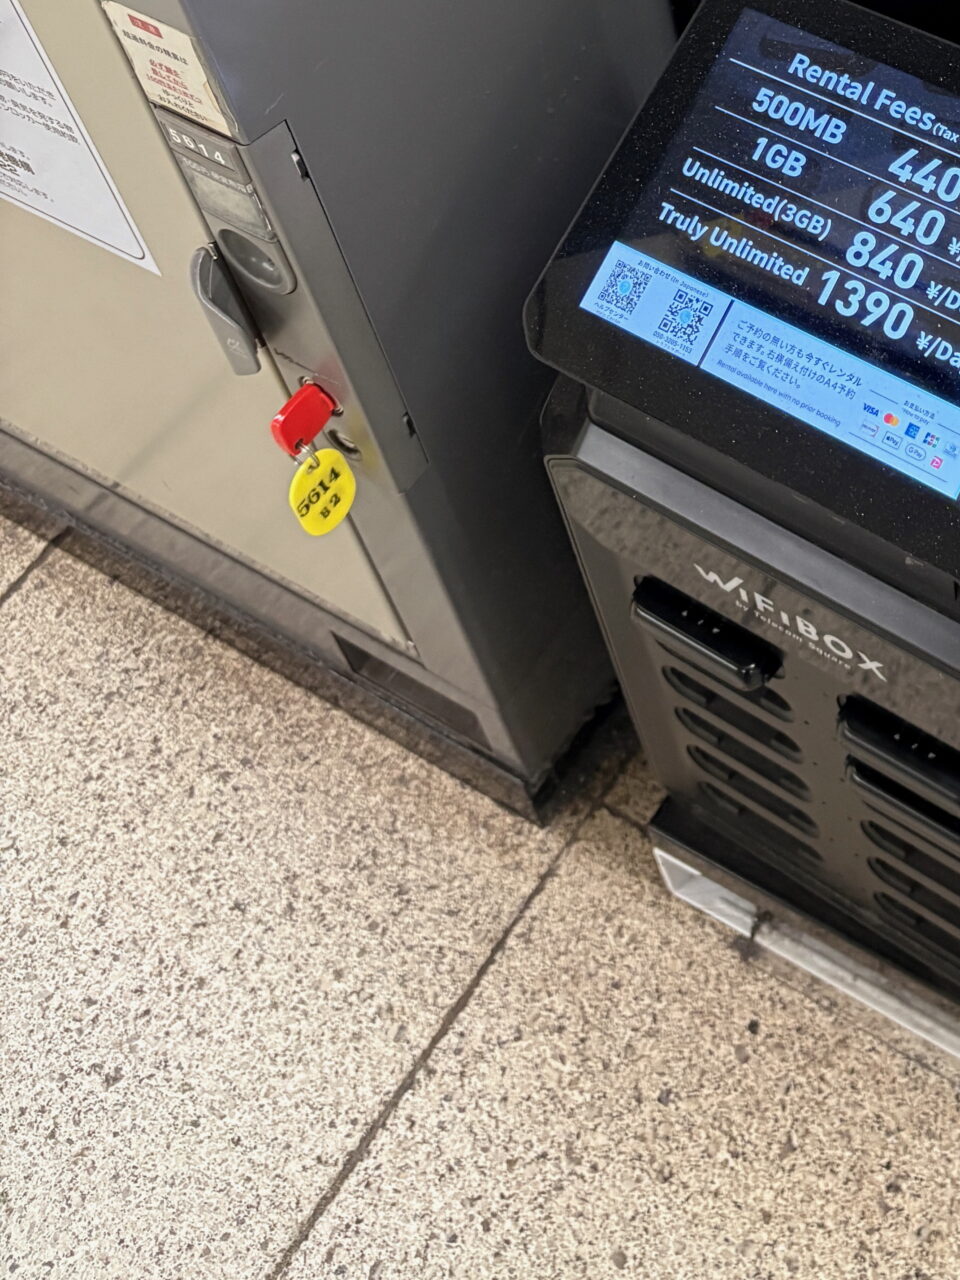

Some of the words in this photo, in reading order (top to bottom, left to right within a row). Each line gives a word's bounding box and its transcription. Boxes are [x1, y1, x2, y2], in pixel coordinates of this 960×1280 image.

[787, 52, 875, 105] Rental
[751, 86, 847, 144] 500MB
[169, 128, 226, 165] 5614
[751, 136, 807, 177] 1GB
[681, 156, 832, 242] Unlimited(3GB)
[867, 189, 946, 246] 640
[658, 201, 710, 241] Truly
[709, 225, 810, 286] Unlimited
[845, 230, 924, 290] 840
[593, 301, 629, 321] ヘルプセンター
[817, 269, 915, 340] 1390
[723, 342, 801, 389] 手順をご覧ください。
[736, 319, 862, 387] ご予約の無い方も今すぐレンタル
[716, 358, 737, 373] Rental
[735, 369, 764, 387] available
[762, 382, 778, 395] here
[777, 390, 792, 399] with
[790, 397, 801, 406] no
[798, 401, 817, 413] prior
[814, 408, 841, 428] booking
[862, 402, 879, 417] VISA
[297, 466, 341, 518] 5614
[808, 642, 852, 670] Square
